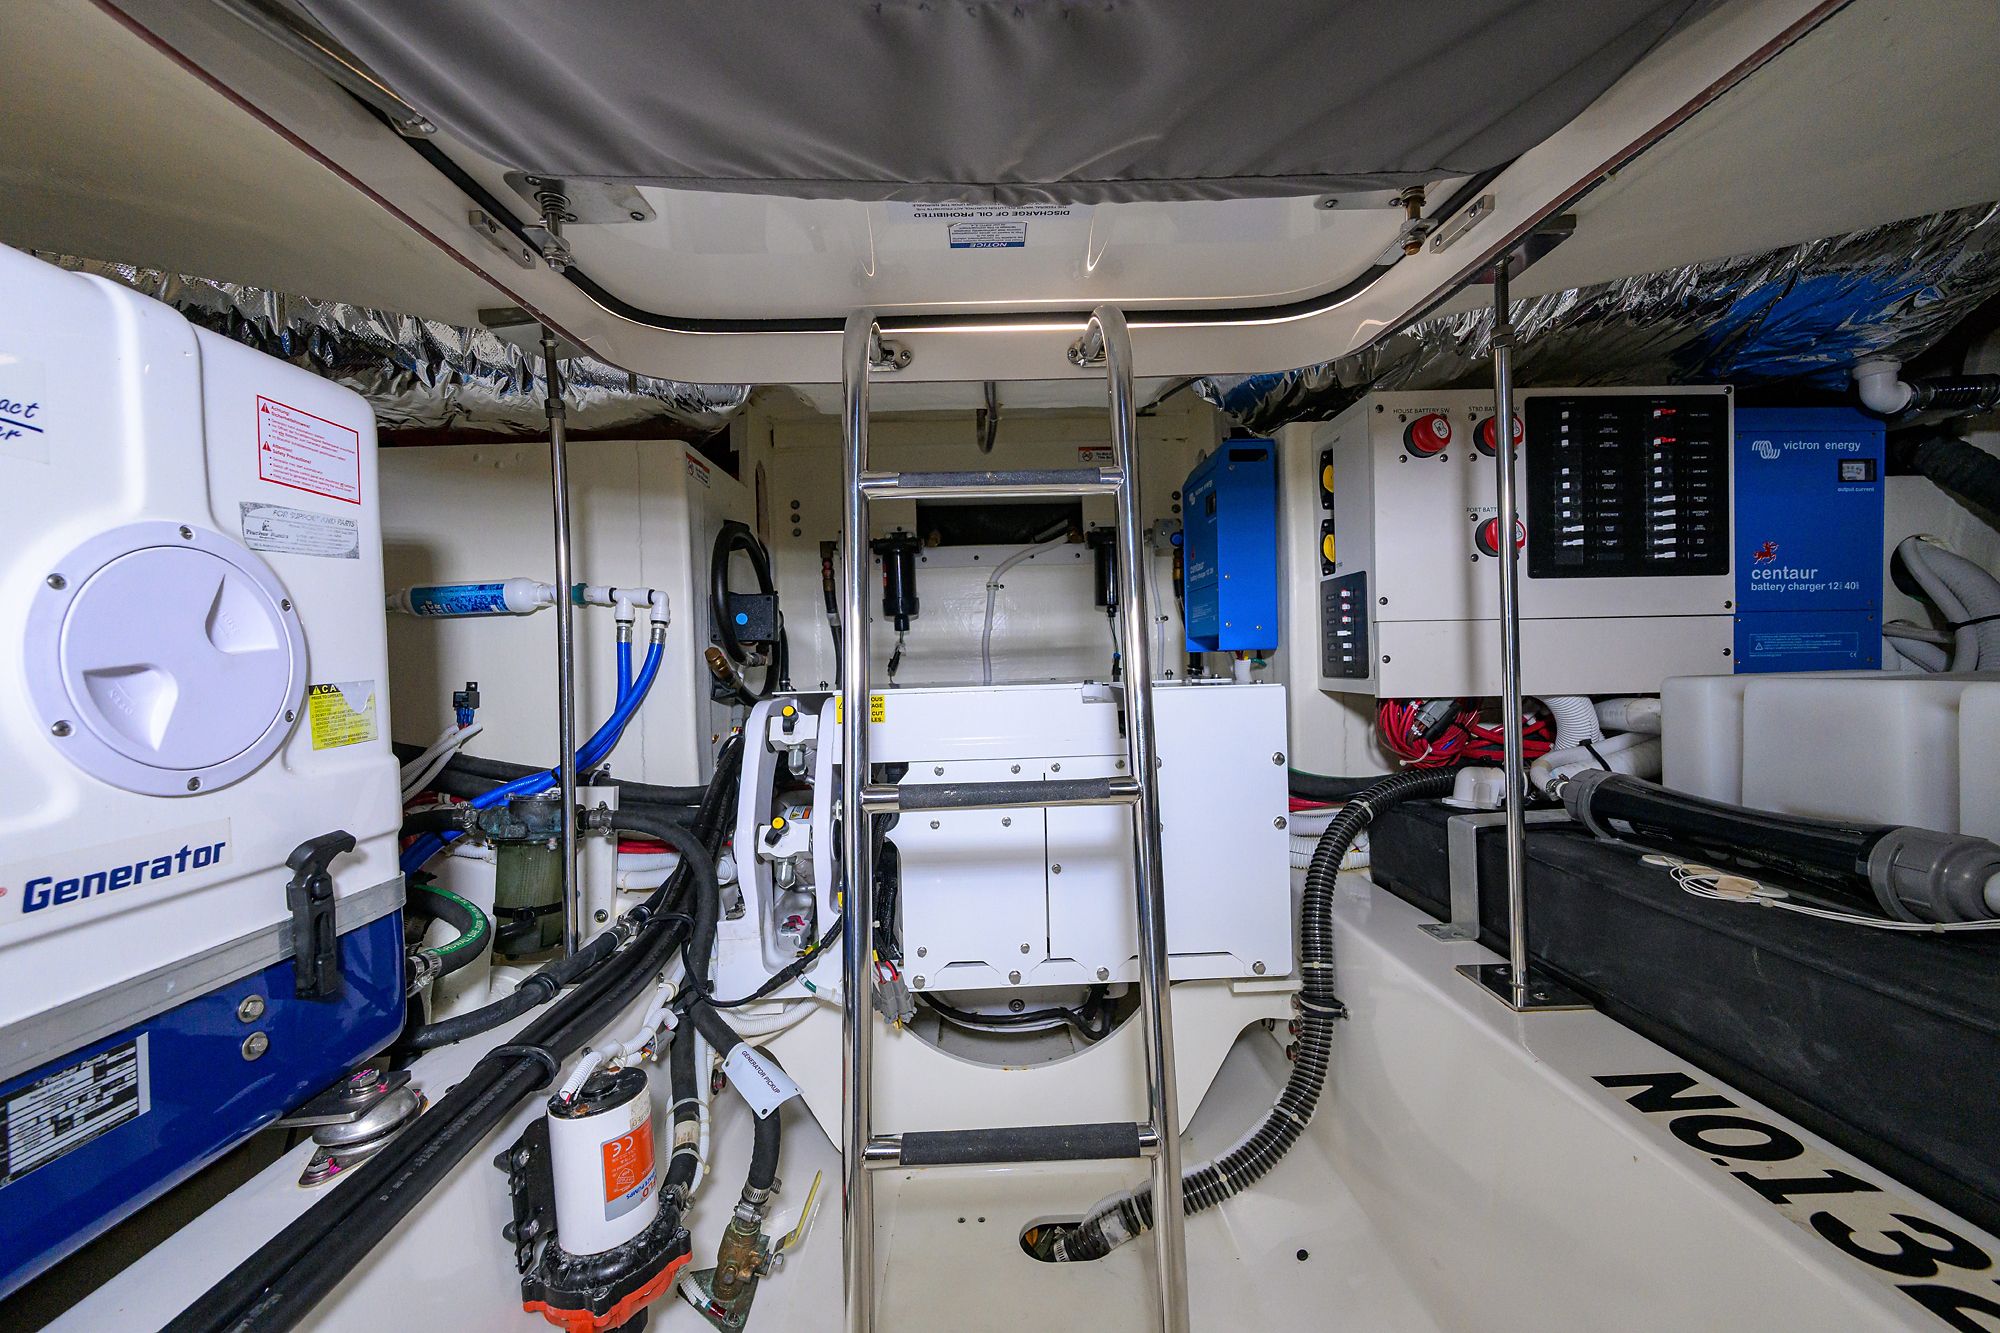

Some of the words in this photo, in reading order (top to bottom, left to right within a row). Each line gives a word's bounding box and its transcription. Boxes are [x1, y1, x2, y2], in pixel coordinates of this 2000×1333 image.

[1783, 441, 1820, 450] victron
[1825, 442, 1861, 452] energy
[1751, 565, 1818, 580] centaur
[1751, 582, 1785, 592] battery
[1788, 582, 1825, 592] charger
[22, 842, 226, 913] Generator
[741, 1050, 767, 1078] GENERATOR
[763, 1076, 781, 1094] PICKUP
